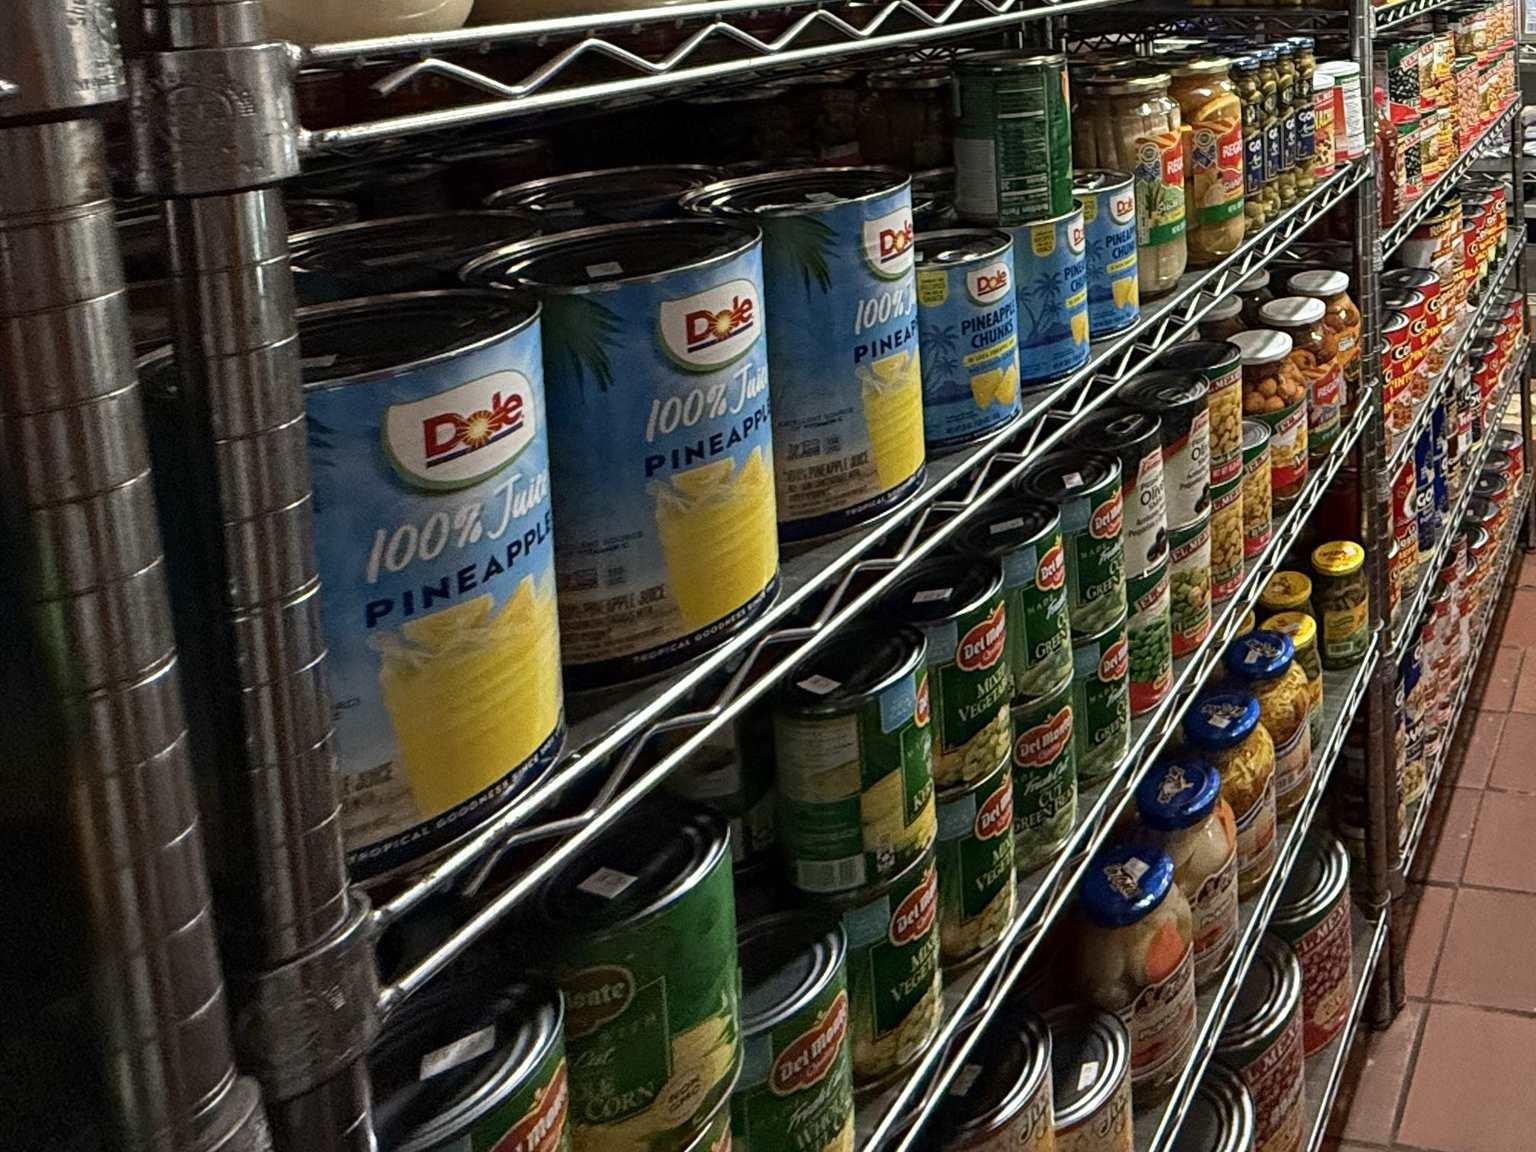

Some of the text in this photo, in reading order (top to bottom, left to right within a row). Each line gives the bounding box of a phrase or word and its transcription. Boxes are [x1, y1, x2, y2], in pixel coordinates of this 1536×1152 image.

[976, 269, 1007, 293] Dole
[685, 295, 754, 346] Dole
[853, 295, 906, 337] 100%
[421, 391, 525, 459] Dole
[646, 382, 728, 443] 100%
[366, 501, 483, 584] 100%
[964, 638, 984, 660] Del
[1019, 737, 1041, 758] Del
[896, 910, 914, 934] Del
[781, 1049, 809, 1082] Del
